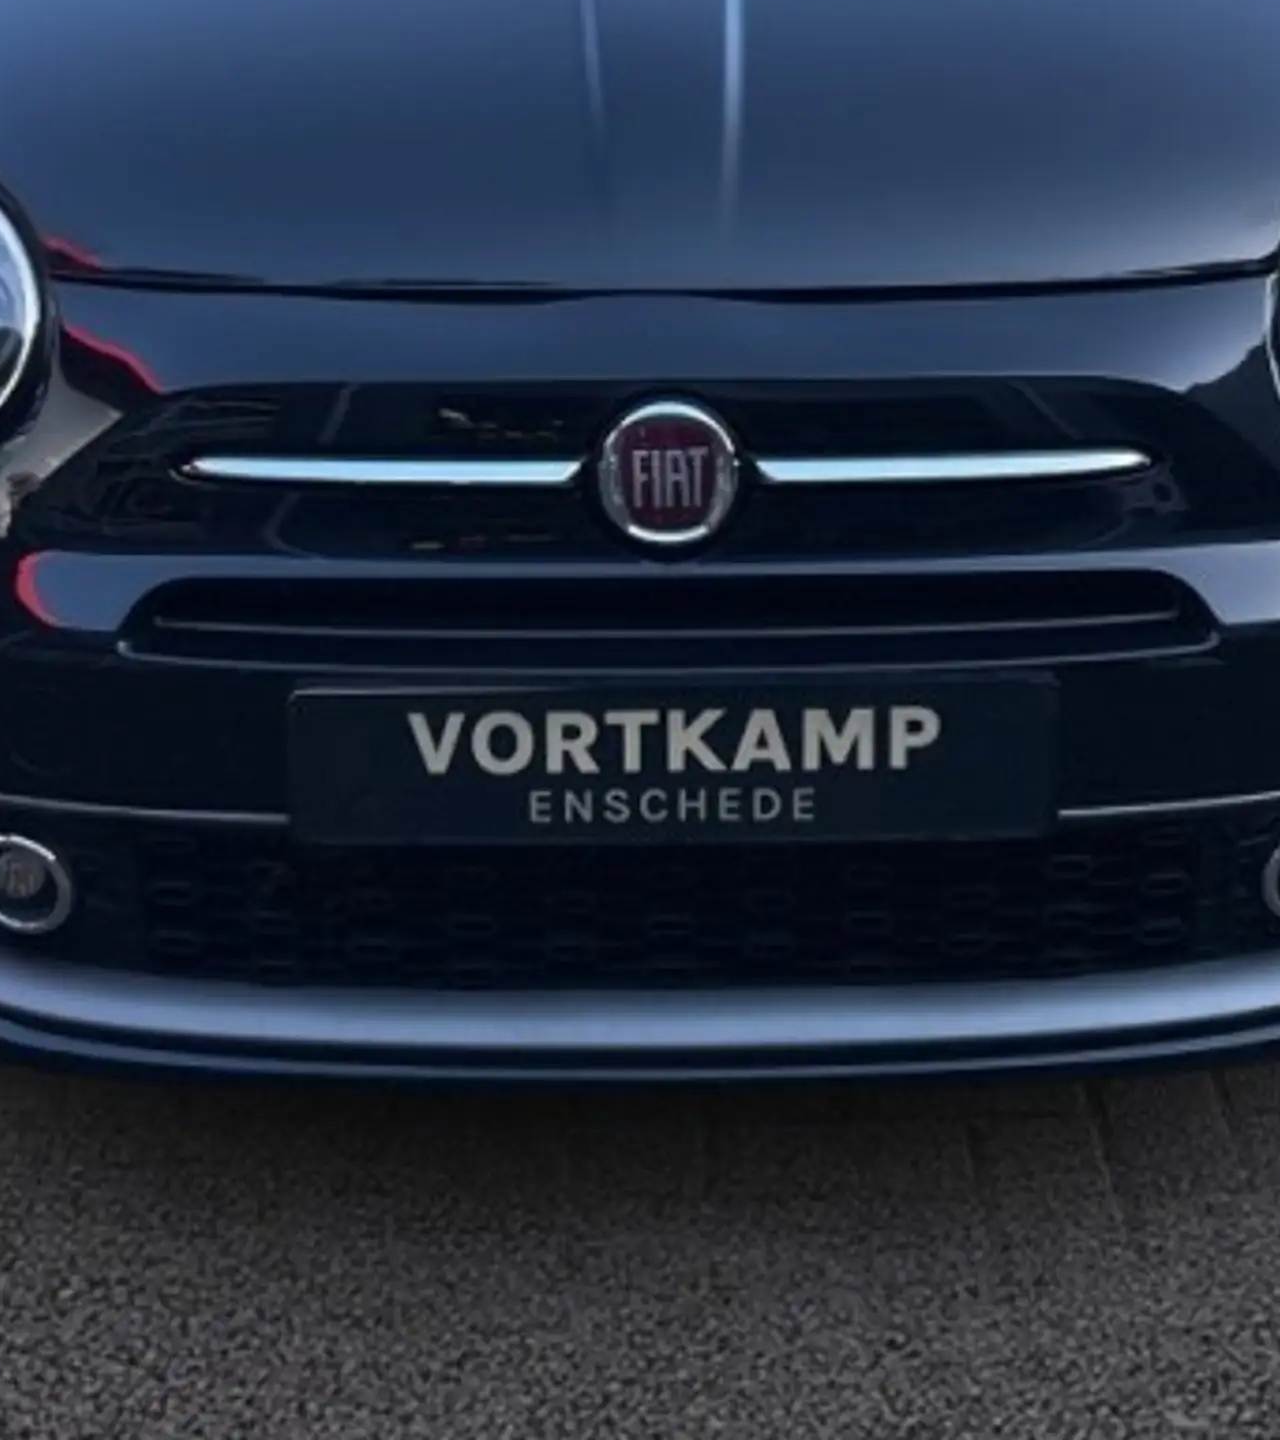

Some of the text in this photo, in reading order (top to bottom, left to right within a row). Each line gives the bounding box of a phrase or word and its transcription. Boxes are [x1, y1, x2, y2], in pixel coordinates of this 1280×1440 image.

[631, 446, 709, 508] FIAT
[407, 706, 942, 775] VORTKAMP
[529, 787, 816, 824] ENSCHEDE
